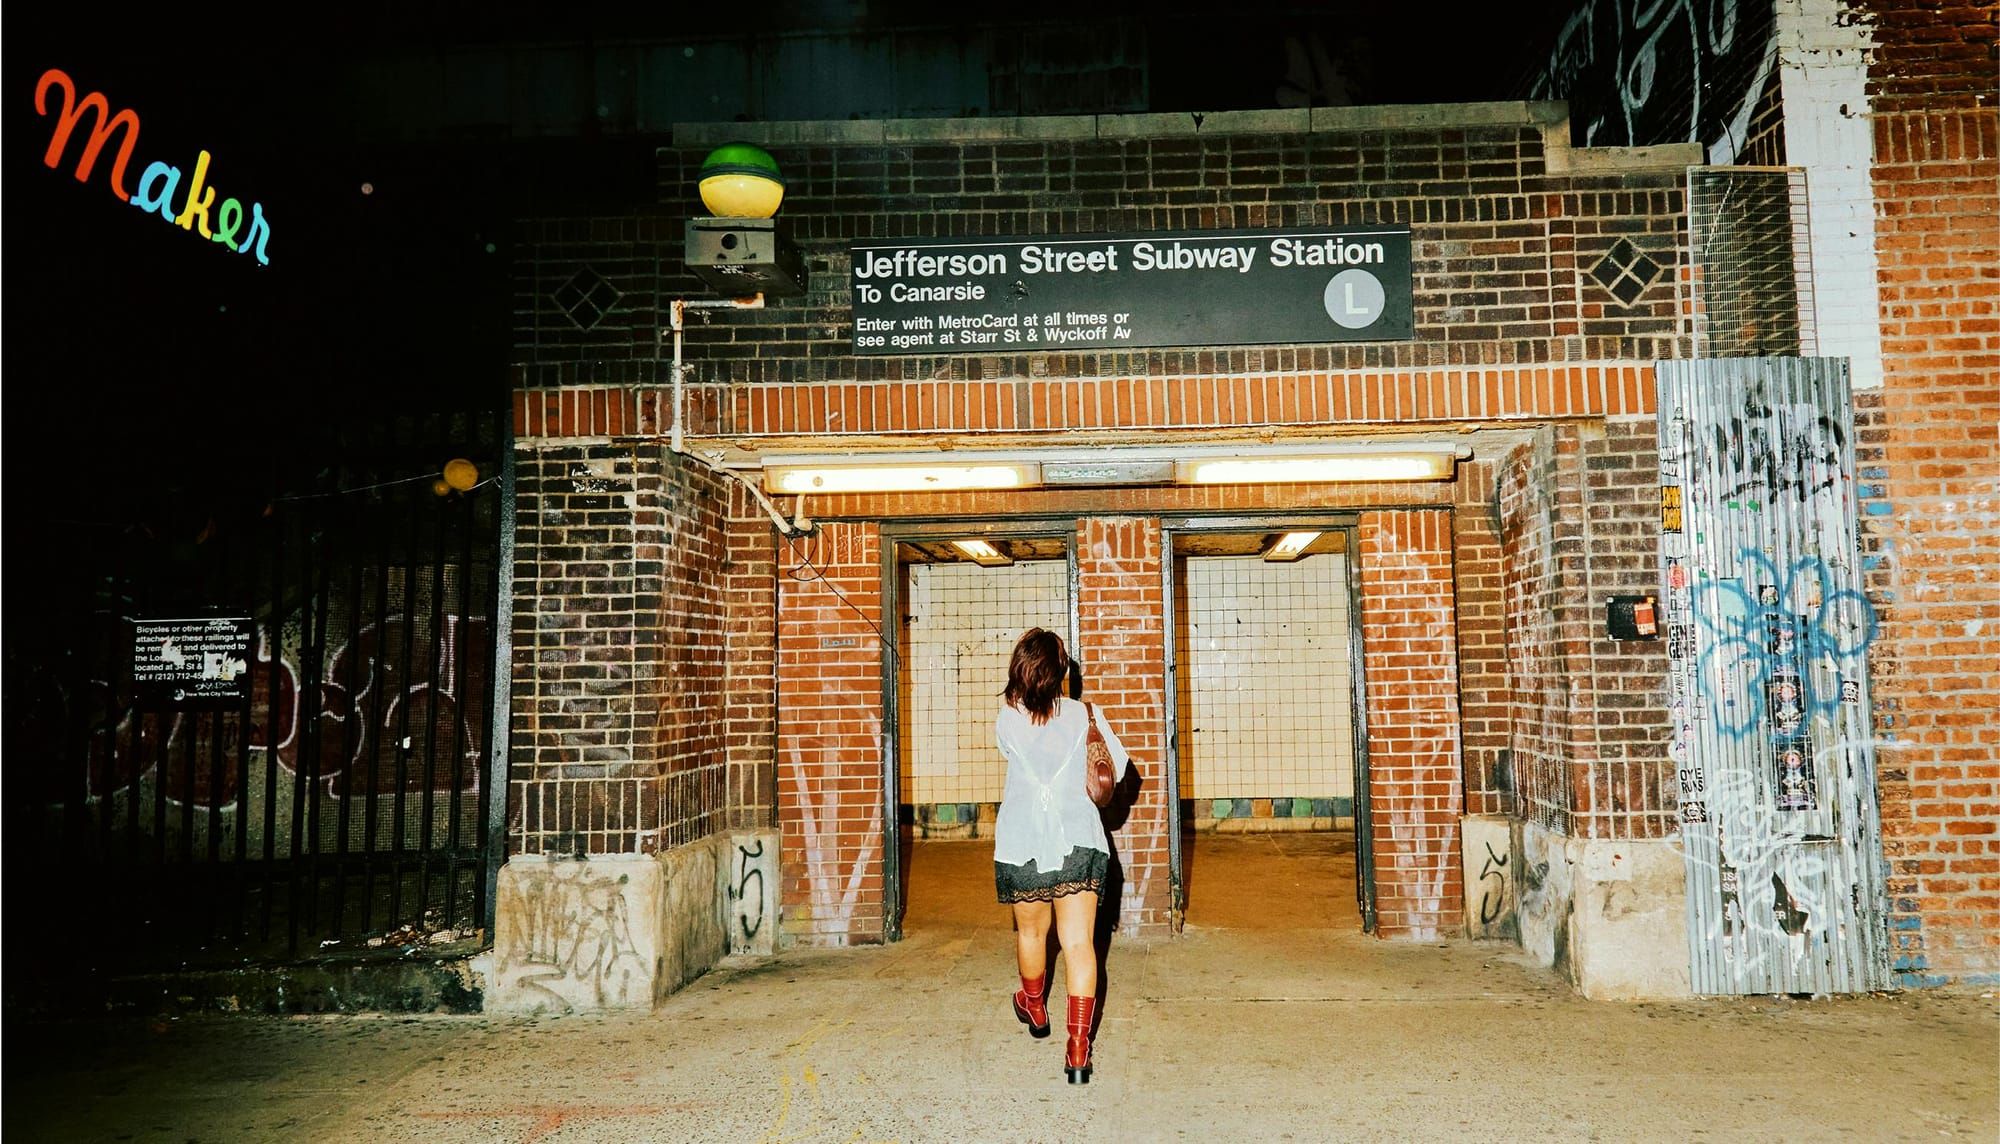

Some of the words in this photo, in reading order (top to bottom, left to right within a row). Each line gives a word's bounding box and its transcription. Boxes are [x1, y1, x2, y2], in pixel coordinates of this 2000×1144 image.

[34, 68, 270, 266] Maker
[855, 250, 1007, 279] Jefferson
[1020, 245, 1118, 274] Street
[1132, 242, 1257, 273] Subway
[1270, 238, 1384, 267] Station
[856, 284, 882, 303] To
[890, 281, 985, 303] Canarsie
[1344, 283, 1369, 315] L
[856, 318, 896, 332] Enter
[902, 316, 933, 330] with
[938, 313, 1018, 330] MetroCard
[1023, 313, 1038, 327] at
[1044, 312, 1060, 326] all
[1066, 312, 1108, 325] times
[1113, 312, 1130, 324] or
[857, 335, 885, 347] see
[891, 332, 934, 348] agent
[939, 331, 955, 345] at
[960, 329, 999, 344] Starr
[1003, 328, 1021, 343] St
[1026, 328, 1038, 342] &
[1044, 326, 1108, 343] Wyckoff
[1113, 325, 1132, 340] Av
[136, 626, 169, 635] Bicycles
[182, 625, 203, 633] other
[204, 624, 238, 633] property
[181, 634, 203, 642] these
[205, 633, 234, 643] railings
[236, 632, 250, 641] will
[183, 643, 198, 651] and
[200, 643, 236, 651] delivered
[186, 662, 195, 670] St
